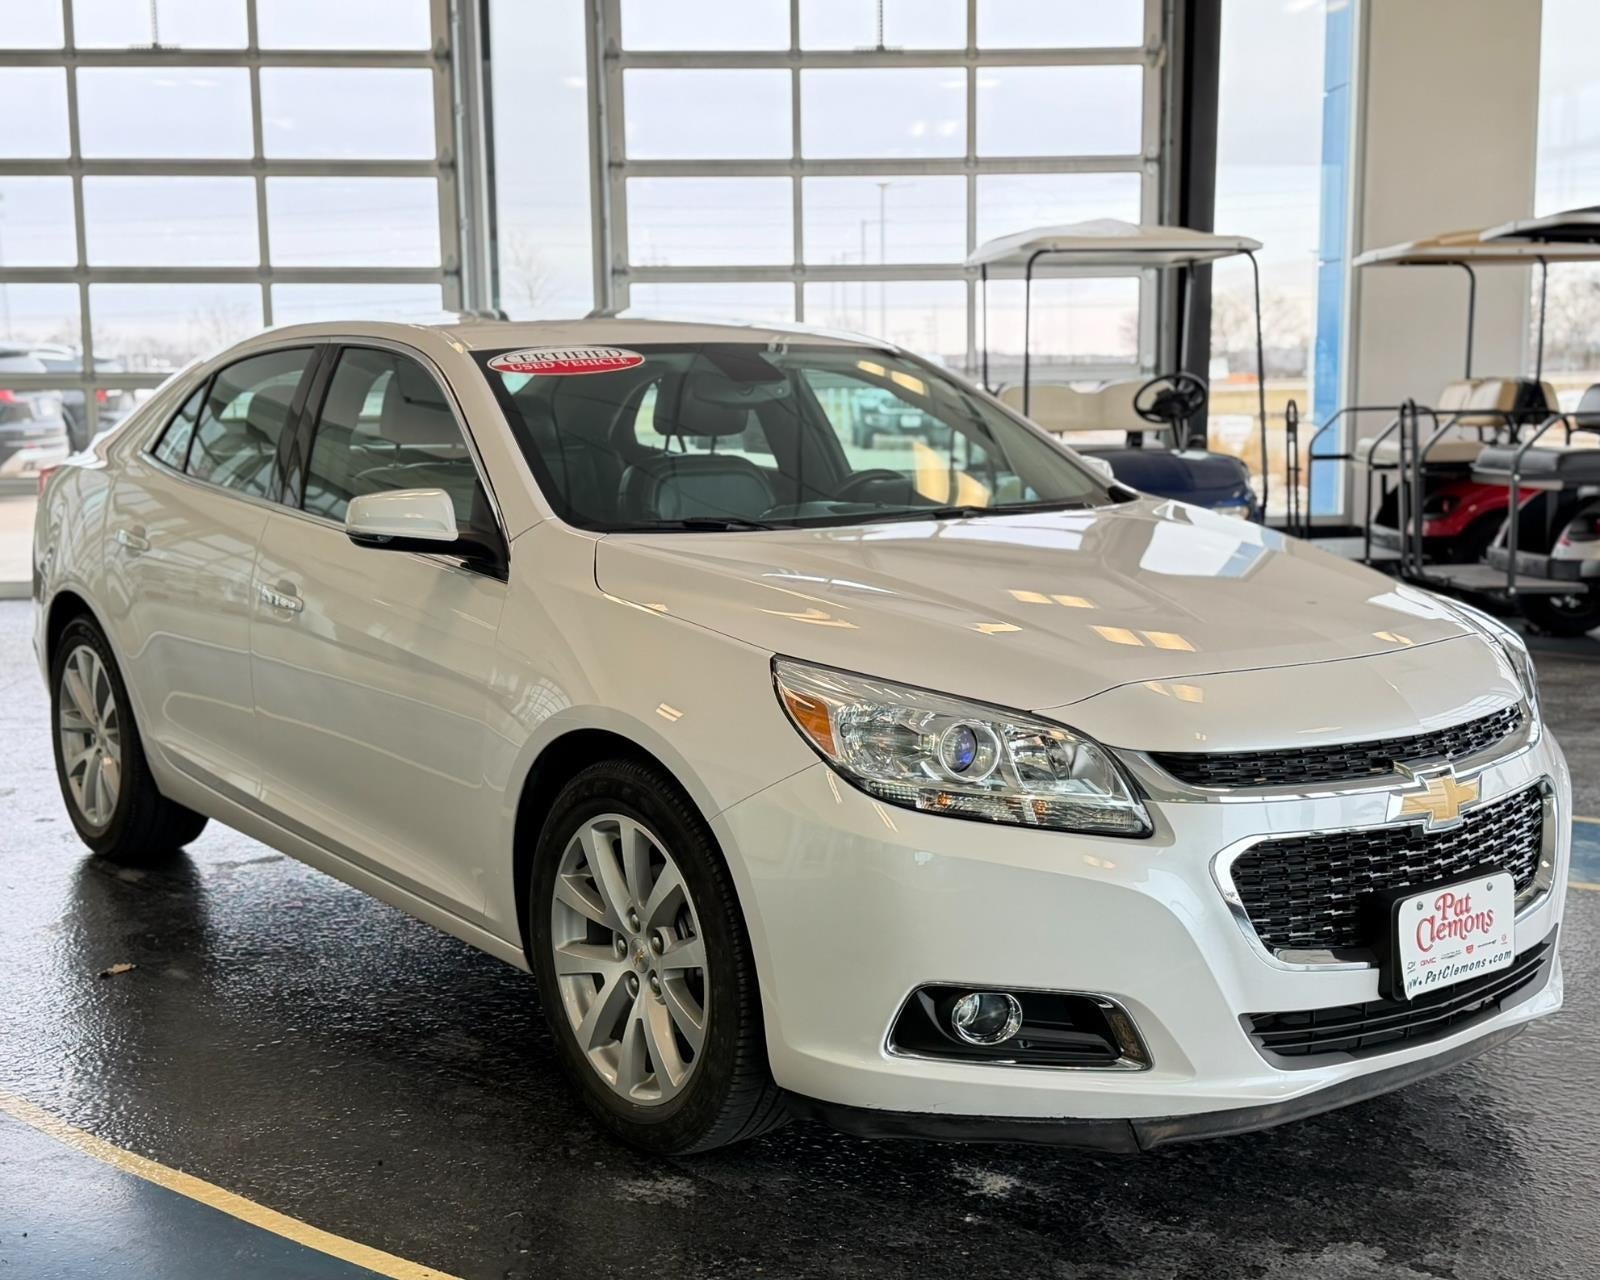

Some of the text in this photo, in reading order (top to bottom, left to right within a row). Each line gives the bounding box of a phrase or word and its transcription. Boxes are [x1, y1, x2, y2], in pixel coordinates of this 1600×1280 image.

[503, 350, 623, 362] CERTIFIED
[510, 357, 630, 371] USED VEHICLE
[1434, 892, 1472, 921] Pat
[1416, 908, 1494, 952] Clemons
